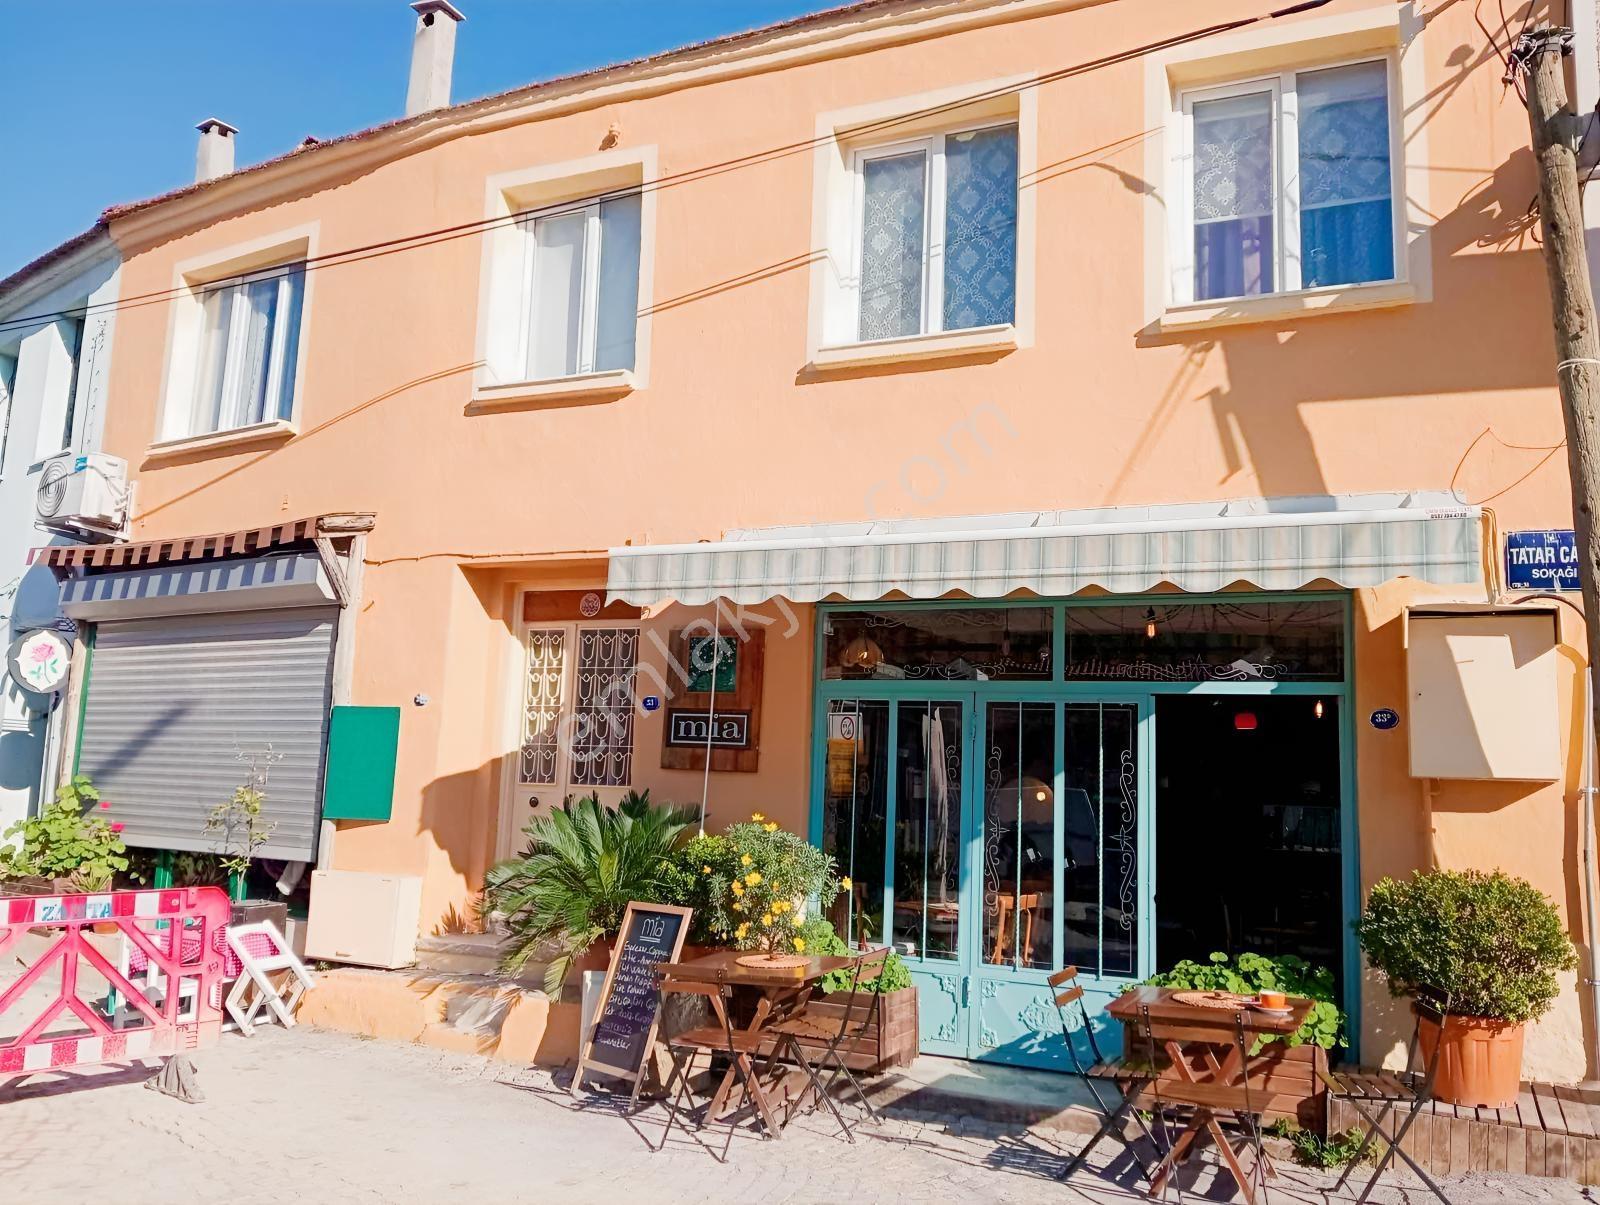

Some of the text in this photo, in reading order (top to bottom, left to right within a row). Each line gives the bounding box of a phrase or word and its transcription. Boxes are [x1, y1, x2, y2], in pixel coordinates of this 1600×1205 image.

[1510, 546, 1555, 564] TATAR
[1532, 566, 1577, 578] SOKAĞI
[678, 713, 741, 739] mia
